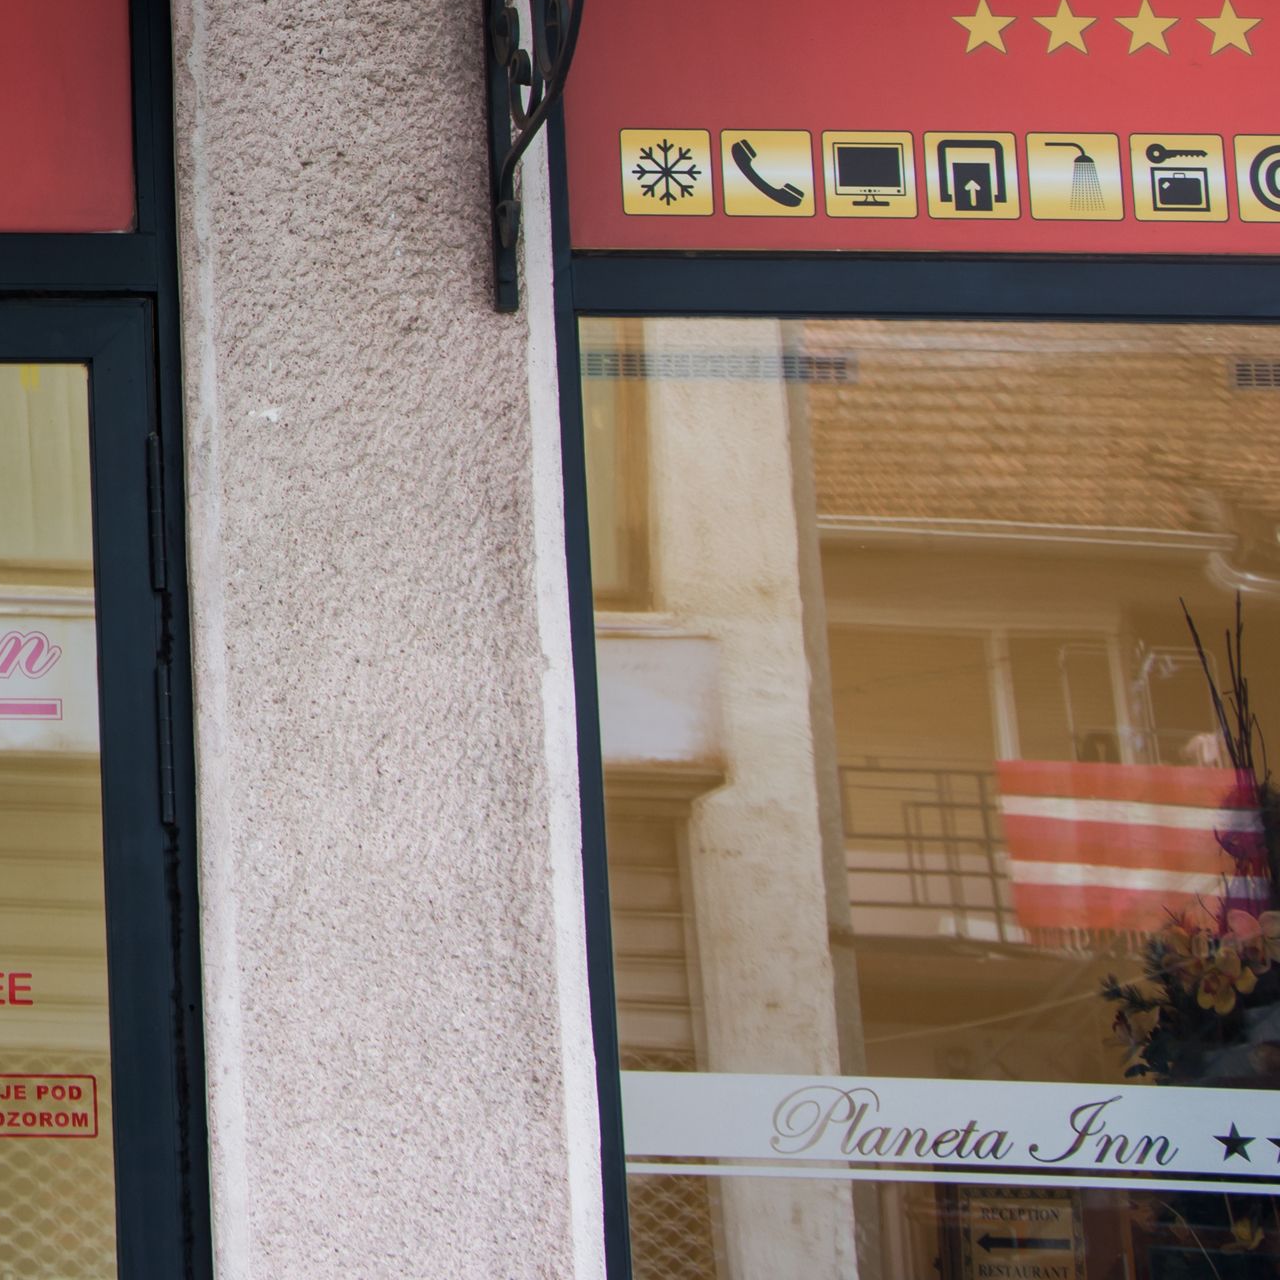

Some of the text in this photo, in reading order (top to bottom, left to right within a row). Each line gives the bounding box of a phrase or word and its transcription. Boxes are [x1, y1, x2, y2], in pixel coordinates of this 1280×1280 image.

[0, 1084, 26, 1100] JE
[37, 1085, 83, 1100] POD
[769, 1085, 1179, 1166] Planeta Inn
[981, 1207, 1060, 1220] RECEPTION
[978, 1263, 1069, 1280] RESTAURANT
